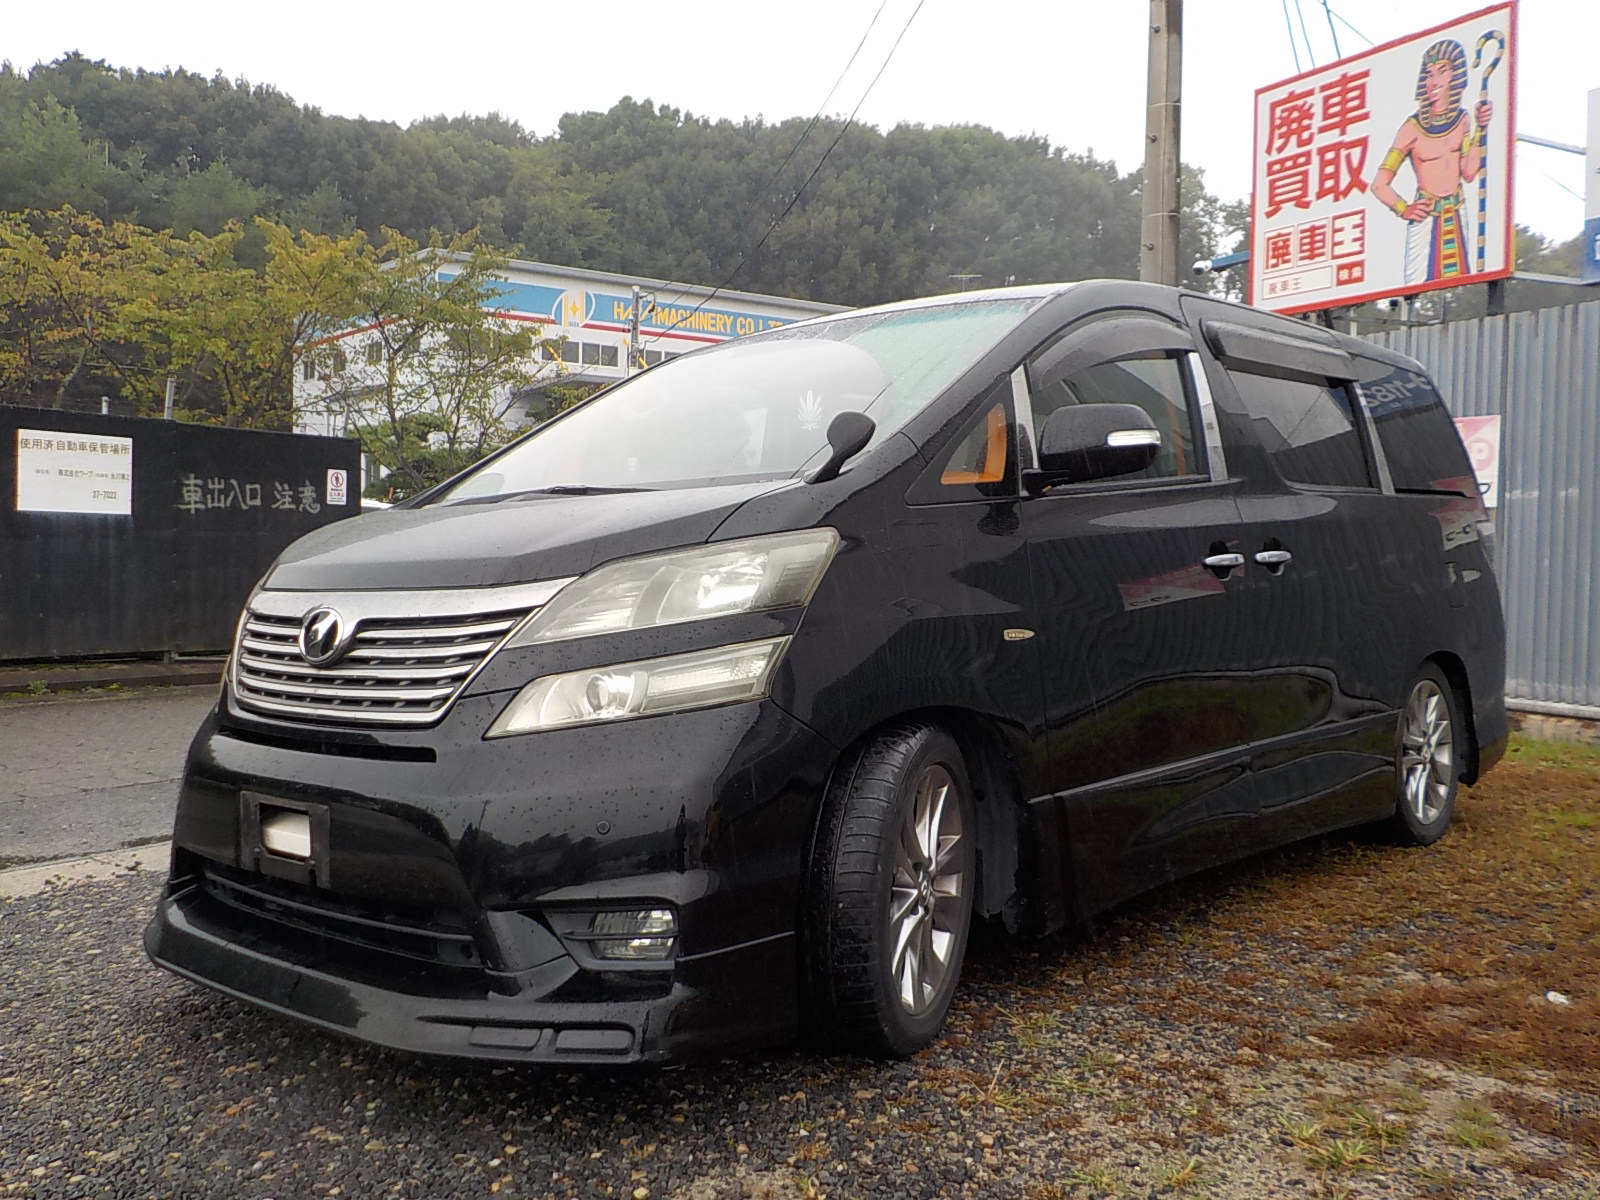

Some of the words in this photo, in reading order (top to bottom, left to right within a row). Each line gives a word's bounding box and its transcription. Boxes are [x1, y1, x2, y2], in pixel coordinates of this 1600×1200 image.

[1264, 68, 1371, 156] 廃車
[1264, 135, 1370, 219] 買取
[1264, 212, 1364, 270] 廃車王
[657, 305, 734, 335] MACHINERY
[20, 438, 130, 455] 使用済自動車保管場所
[179, 473, 261, 514] 車出入口
[271, 479, 321, 514] 注意
